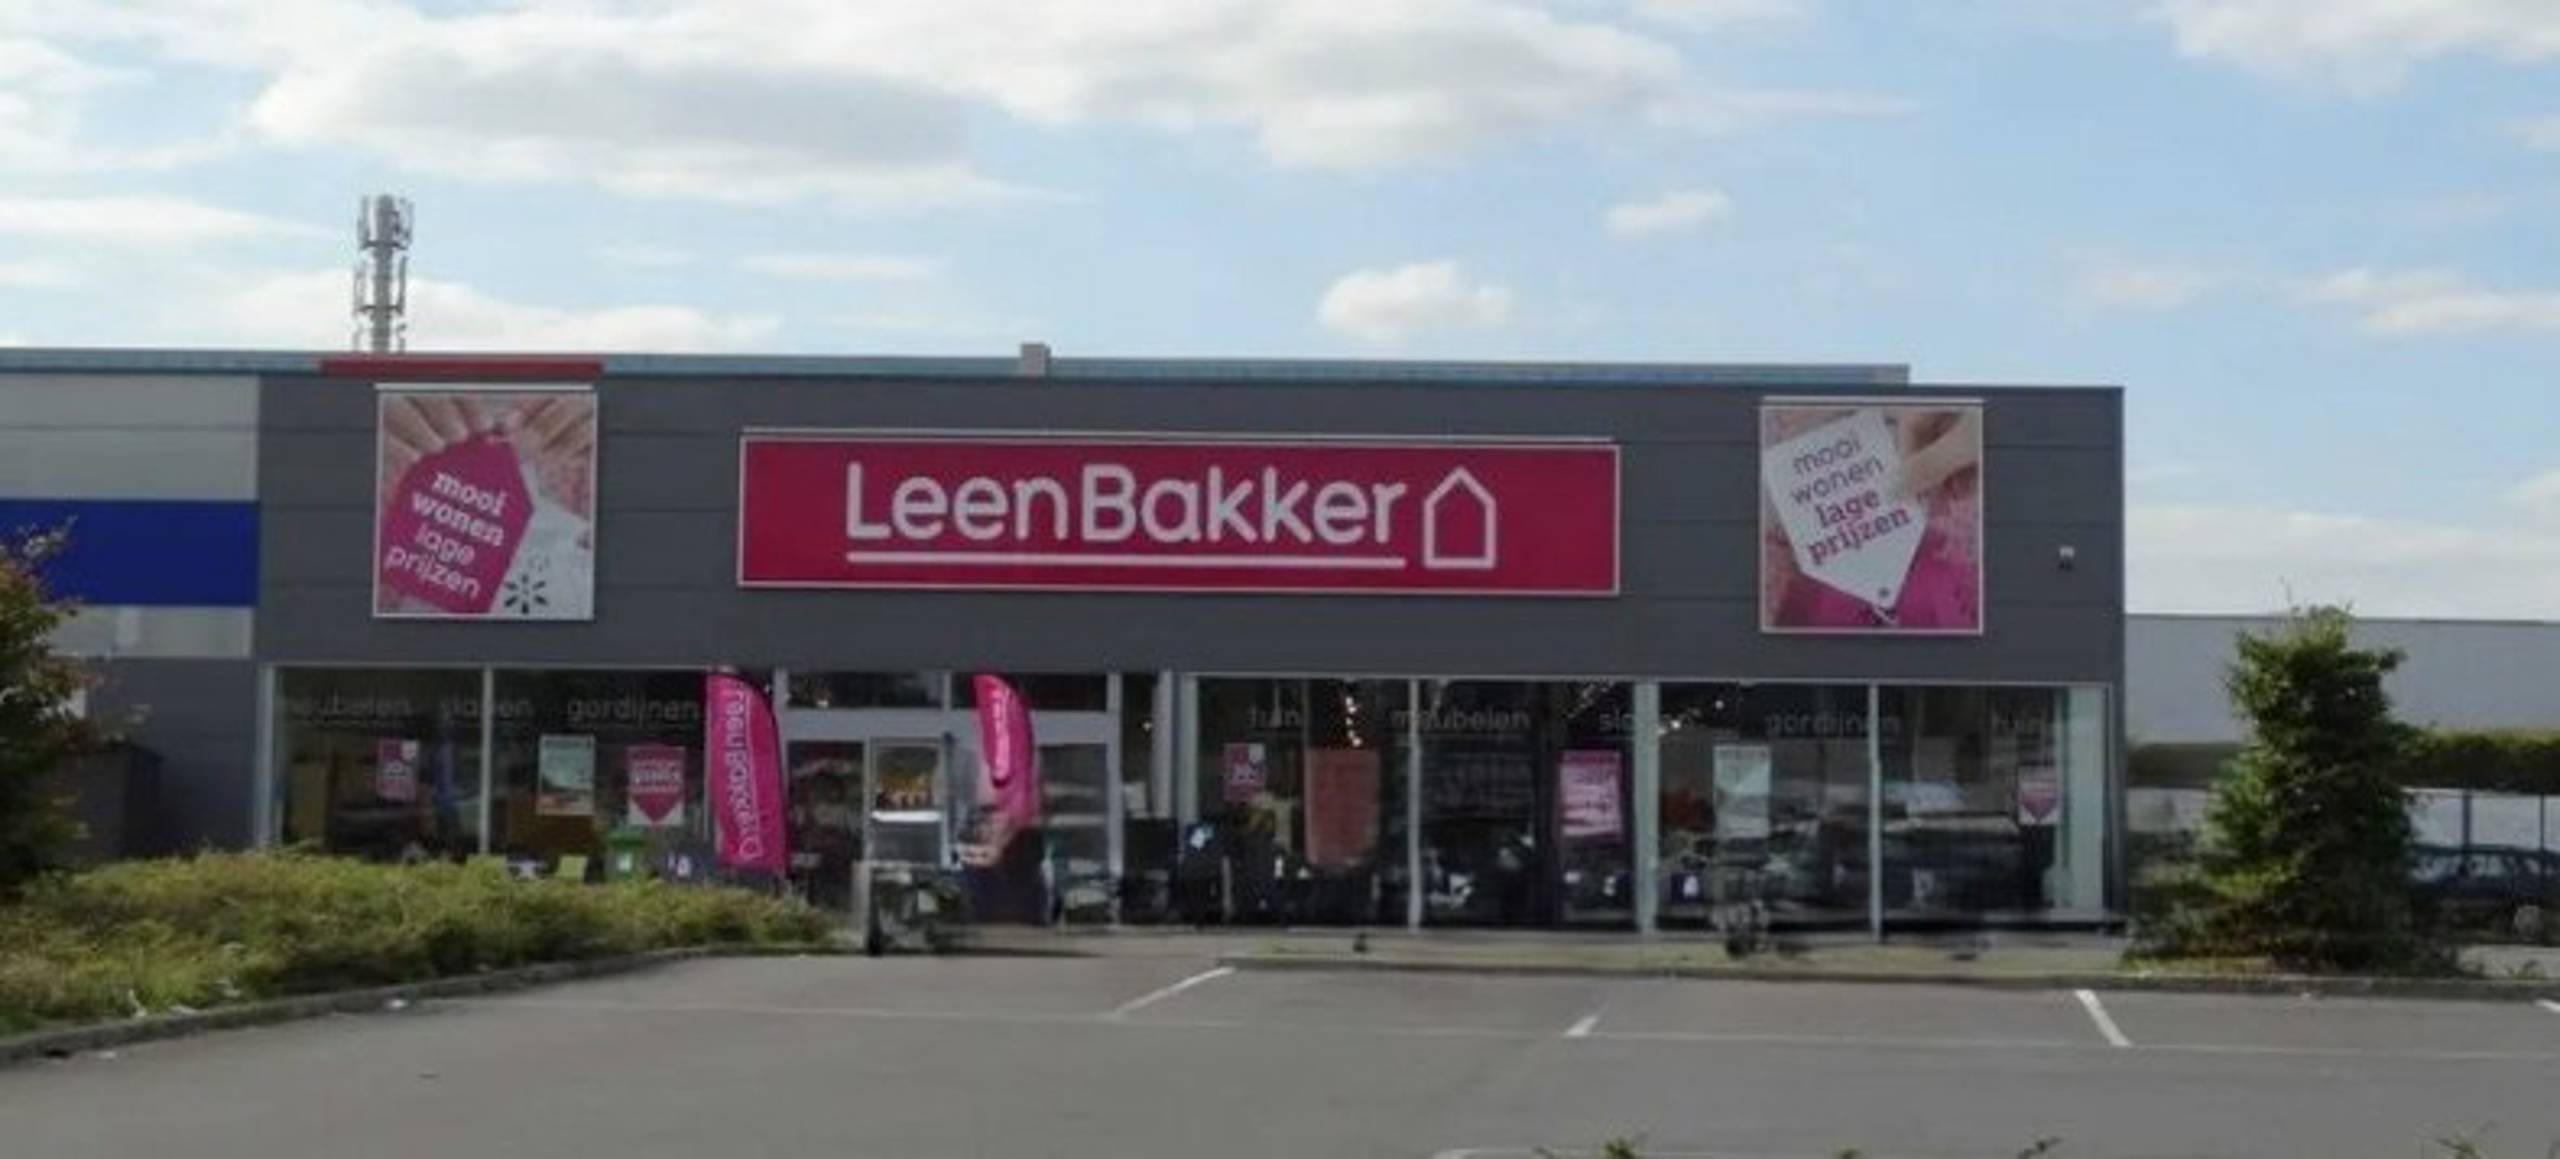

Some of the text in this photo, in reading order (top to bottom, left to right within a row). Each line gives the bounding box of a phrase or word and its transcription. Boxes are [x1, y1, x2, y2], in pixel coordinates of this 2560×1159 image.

[1792, 434, 1861, 475] mooi
[429, 472, 508, 516] mooi
[1790, 455, 1884, 505] wonen
[411, 491, 504, 546] wonen
[846, 462, 1406, 543] LeenBakker
[1815, 489, 1880, 529] lage
[415, 523, 476, 565] lage
[1808, 506, 1910, 566] prijzen
[384, 547, 481, 599] prijzen
[439, 693, 535, 721] slaen
[567, 692, 699, 730] gordijnen
[1390, 705, 1530, 731] mubelen
[1763, 709, 1901, 737] gordijnn
